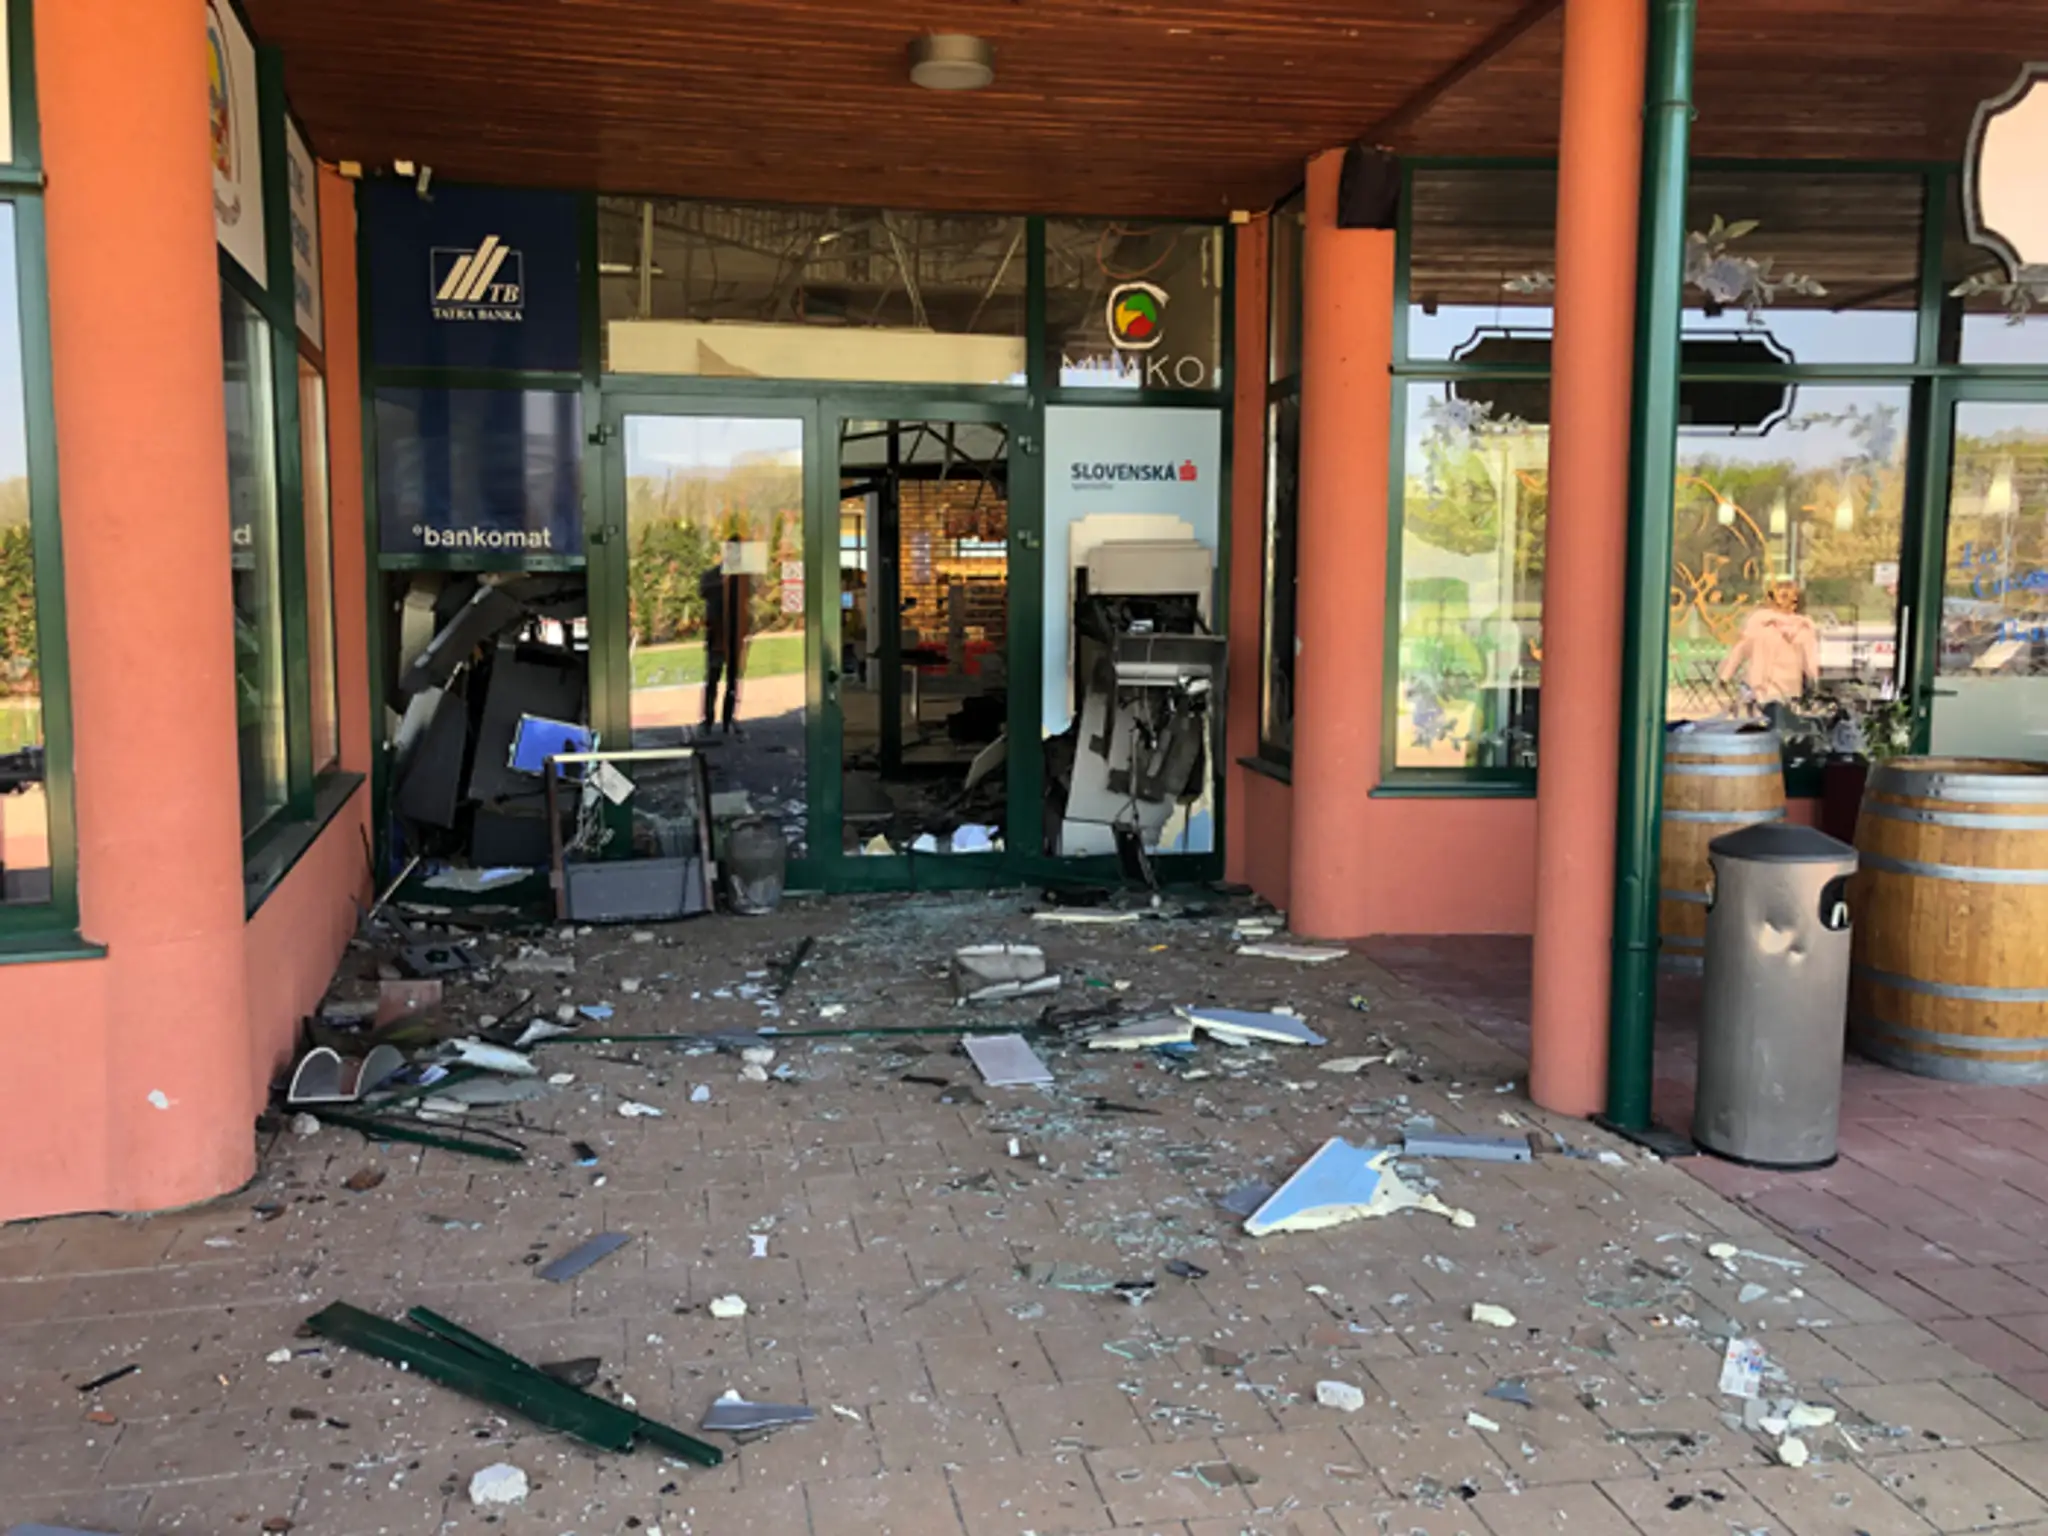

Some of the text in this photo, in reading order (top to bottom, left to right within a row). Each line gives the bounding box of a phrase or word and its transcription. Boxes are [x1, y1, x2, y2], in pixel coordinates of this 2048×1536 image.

[490, 284, 519, 302] TB
[432, 307, 522, 321] TATRA BANKA
